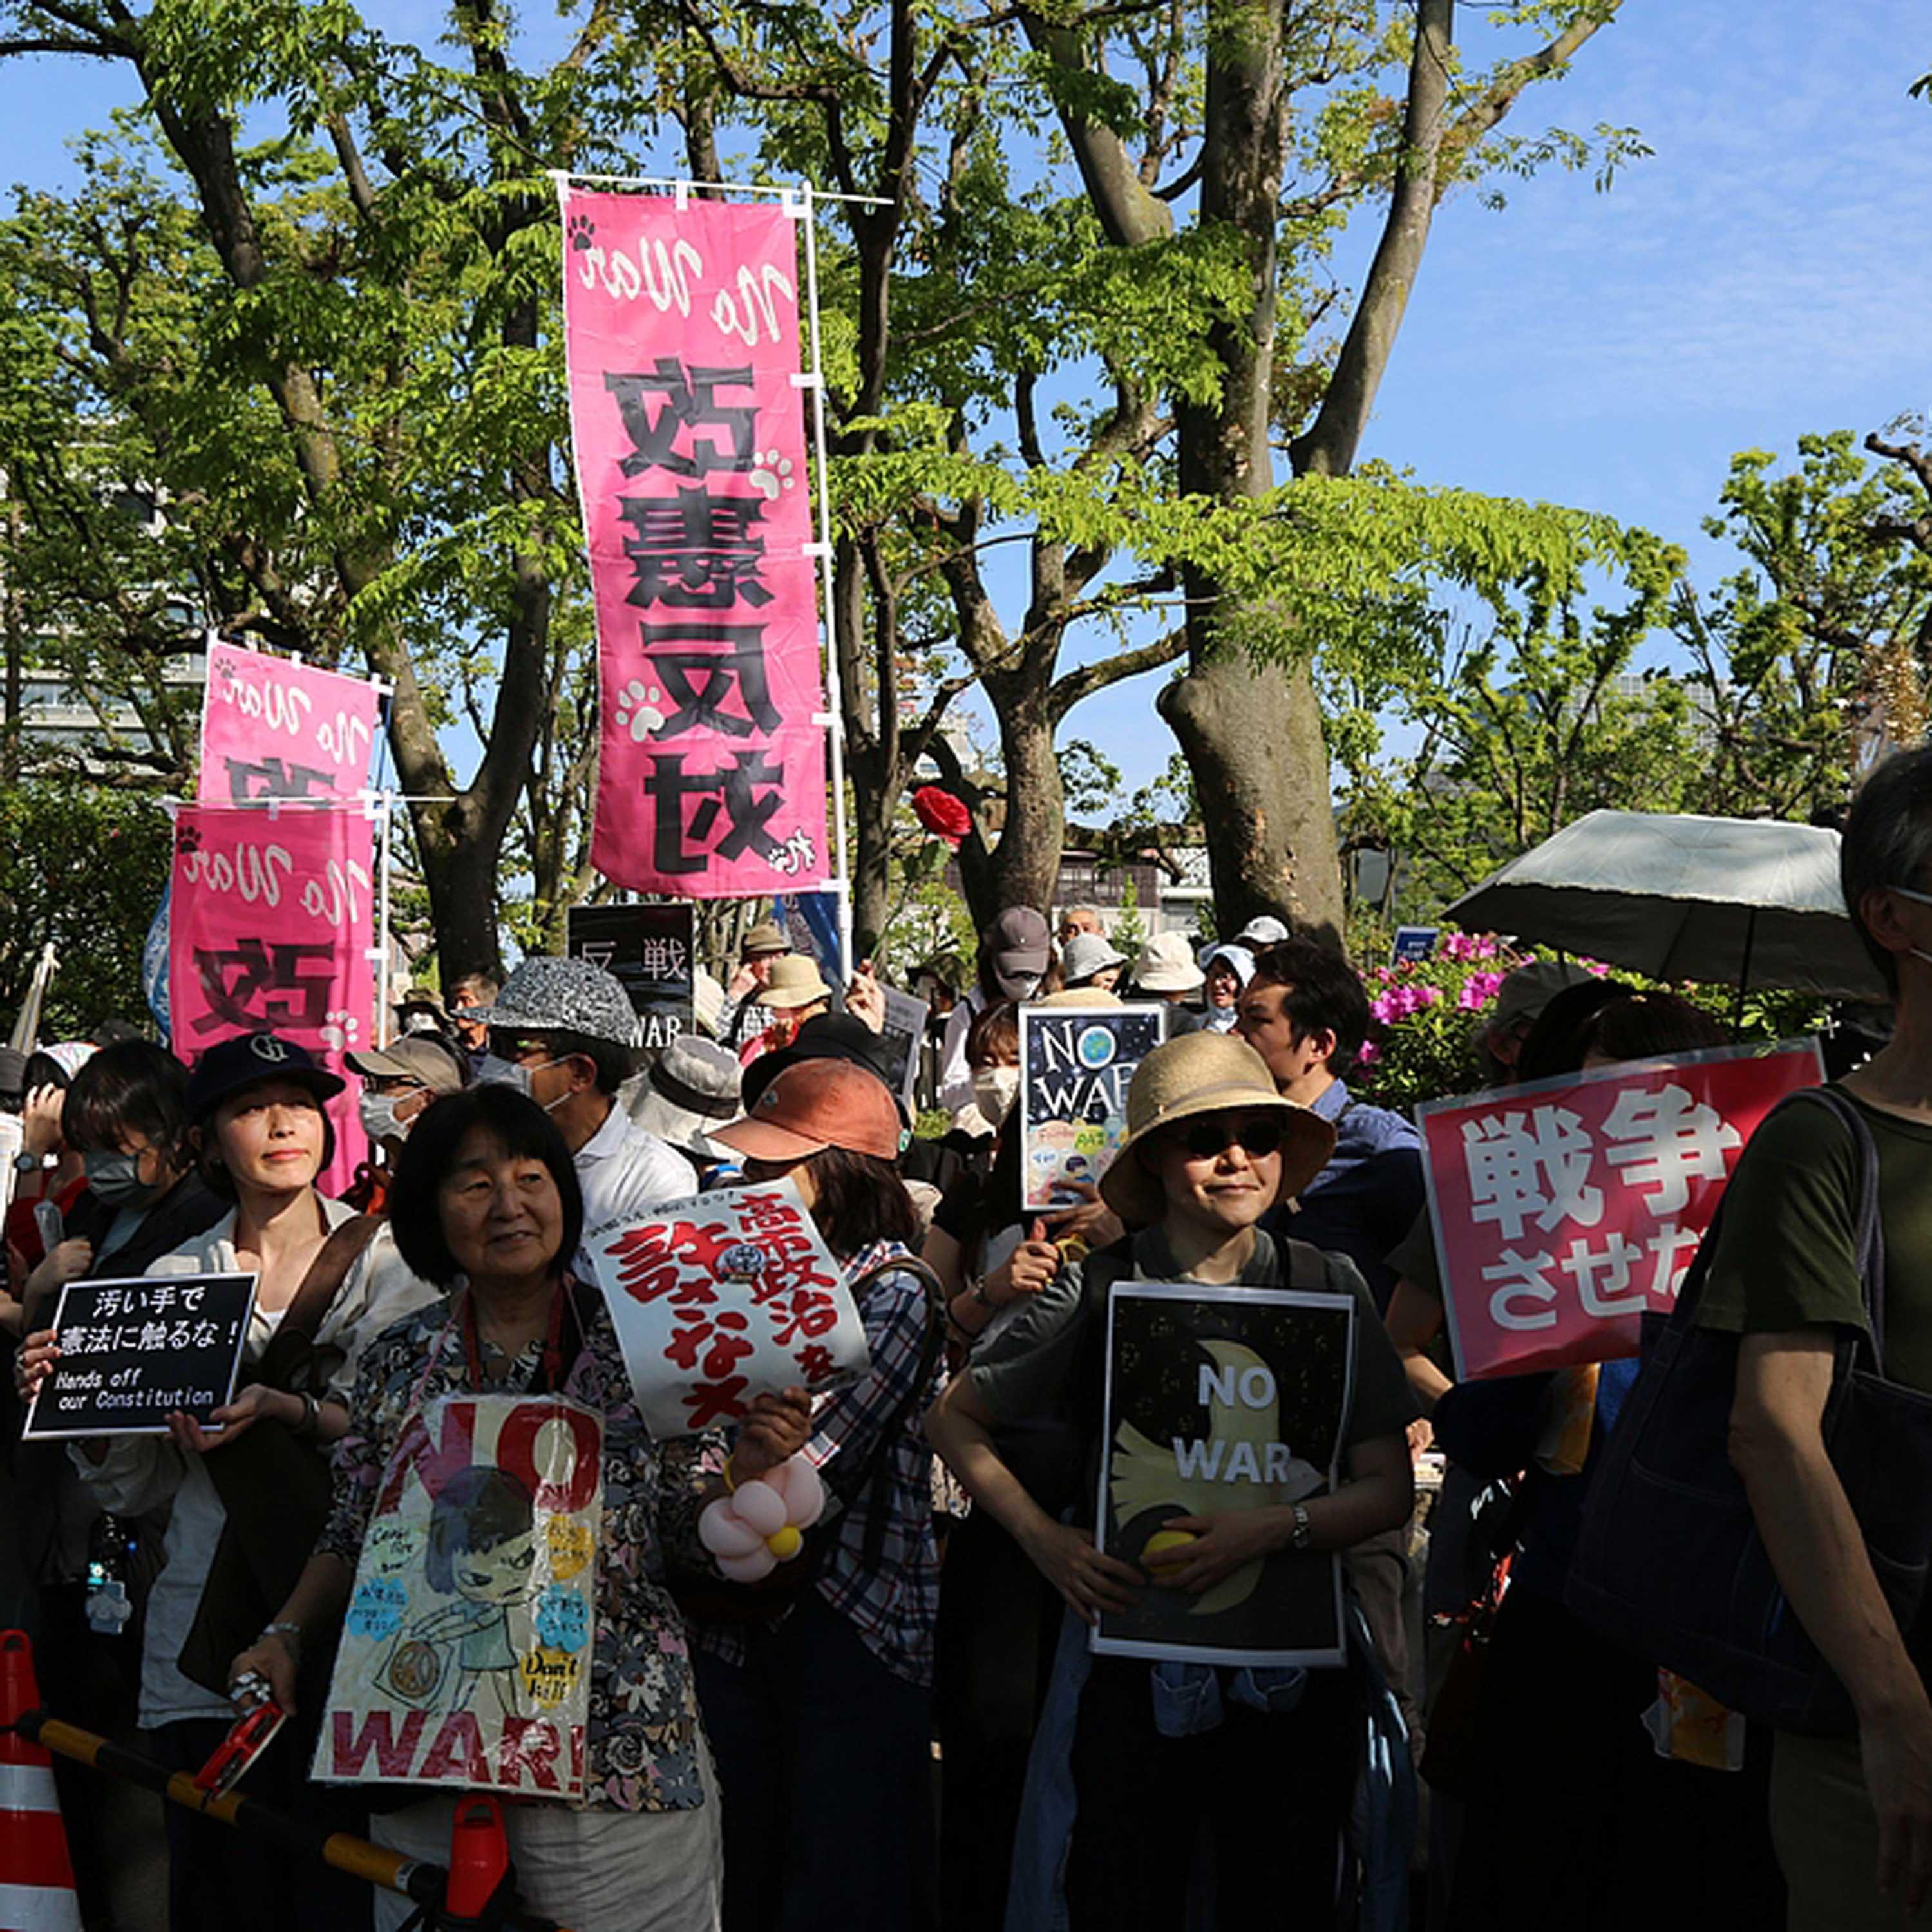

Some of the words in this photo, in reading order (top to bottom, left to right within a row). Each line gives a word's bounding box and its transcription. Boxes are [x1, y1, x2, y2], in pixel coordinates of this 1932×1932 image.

[1041, 1019, 1116, 1070] NO
[1460, 1083, 1743, 1240] 戦争
[92, 1287, 206, 1318] 汚い手で
[59, 1394, 88, 1410] our
[95, 1387, 213, 1410] Constitution
[110, 1367, 143, 1388] off
[1198, 1365, 1276, 1410] NO
[375, 1402, 601, 1517] NO
[1173, 1437, 1292, 1484] WAR
[526, 1651, 578, 1676] Don't
